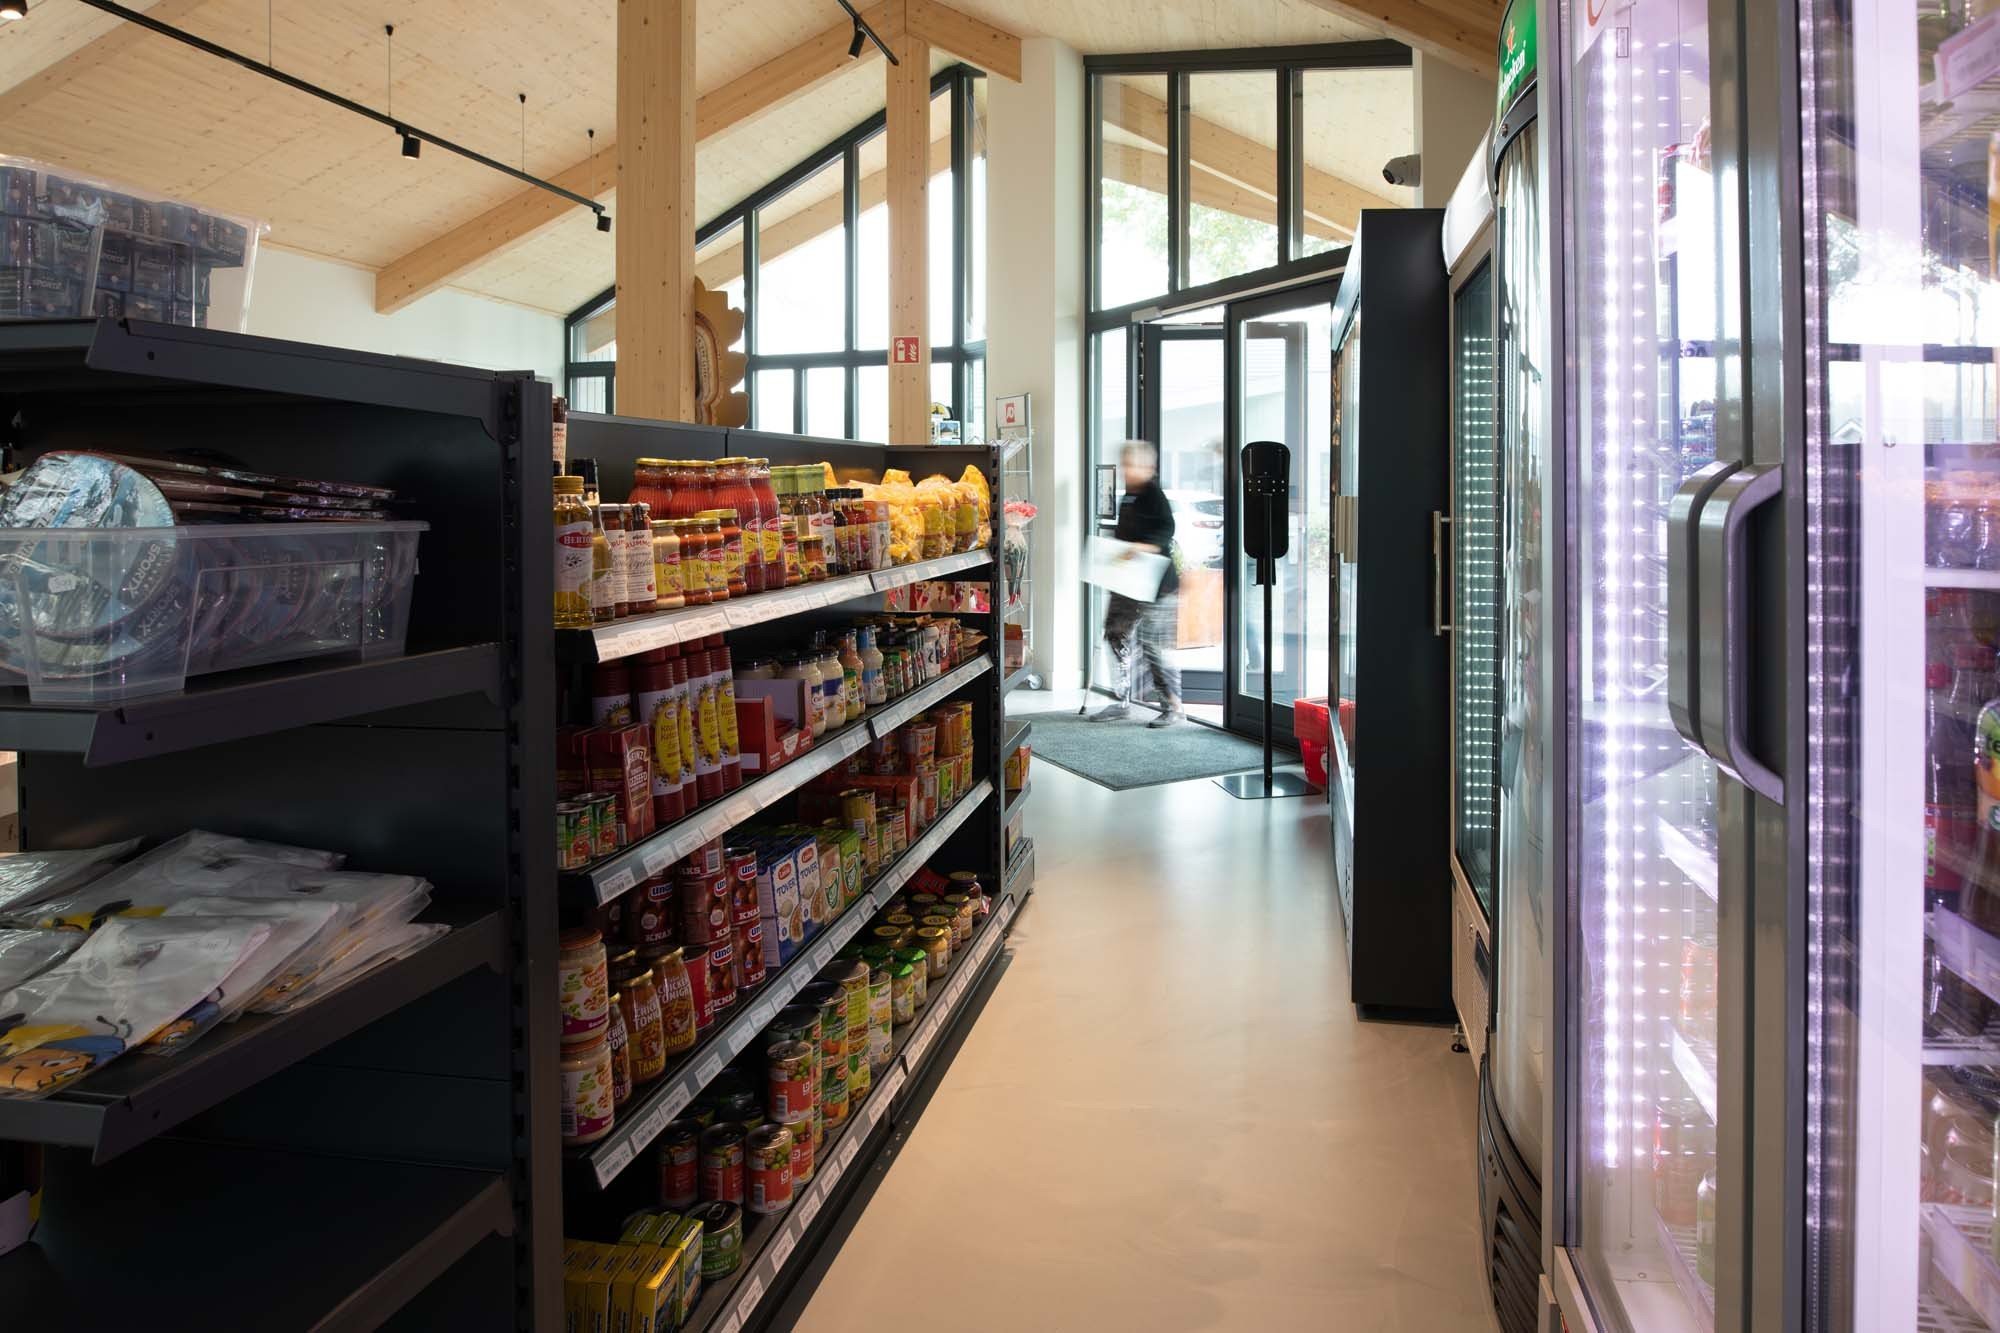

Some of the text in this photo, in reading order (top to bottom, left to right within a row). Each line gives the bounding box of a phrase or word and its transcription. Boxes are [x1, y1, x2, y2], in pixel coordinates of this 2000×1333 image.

[126, 543, 161, 600] SPORTX
[800, 861, 818, 880] TOVER
[776, 878, 796, 897] TOVER
